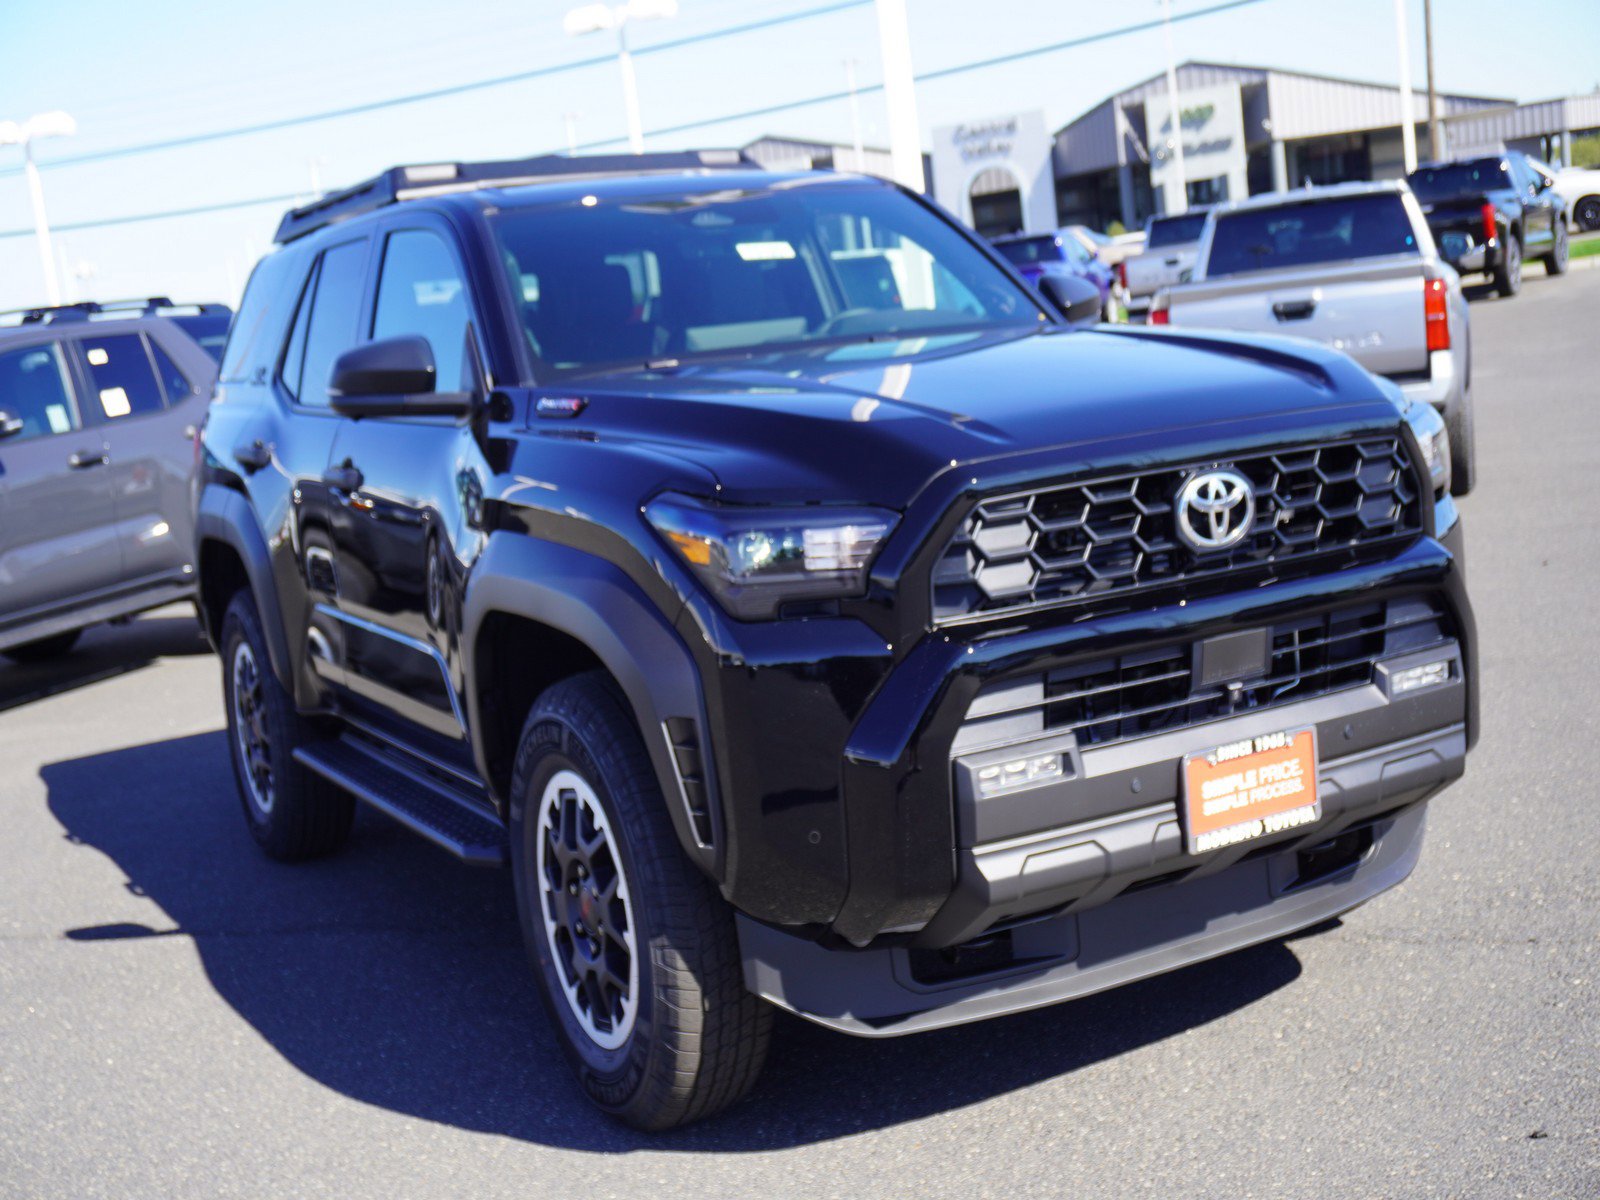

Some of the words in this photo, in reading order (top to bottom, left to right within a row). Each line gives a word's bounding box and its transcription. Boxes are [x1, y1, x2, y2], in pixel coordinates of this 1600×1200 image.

[1202, 769, 1258, 799] SIMPLE
[1259, 758, 1304, 785] PRICE.
[1202, 789, 1249, 816] SIMPLE
[1250, 778, 1305, 804] PROCESS.
[1265, 805, 1316, 833] TOYOTA
